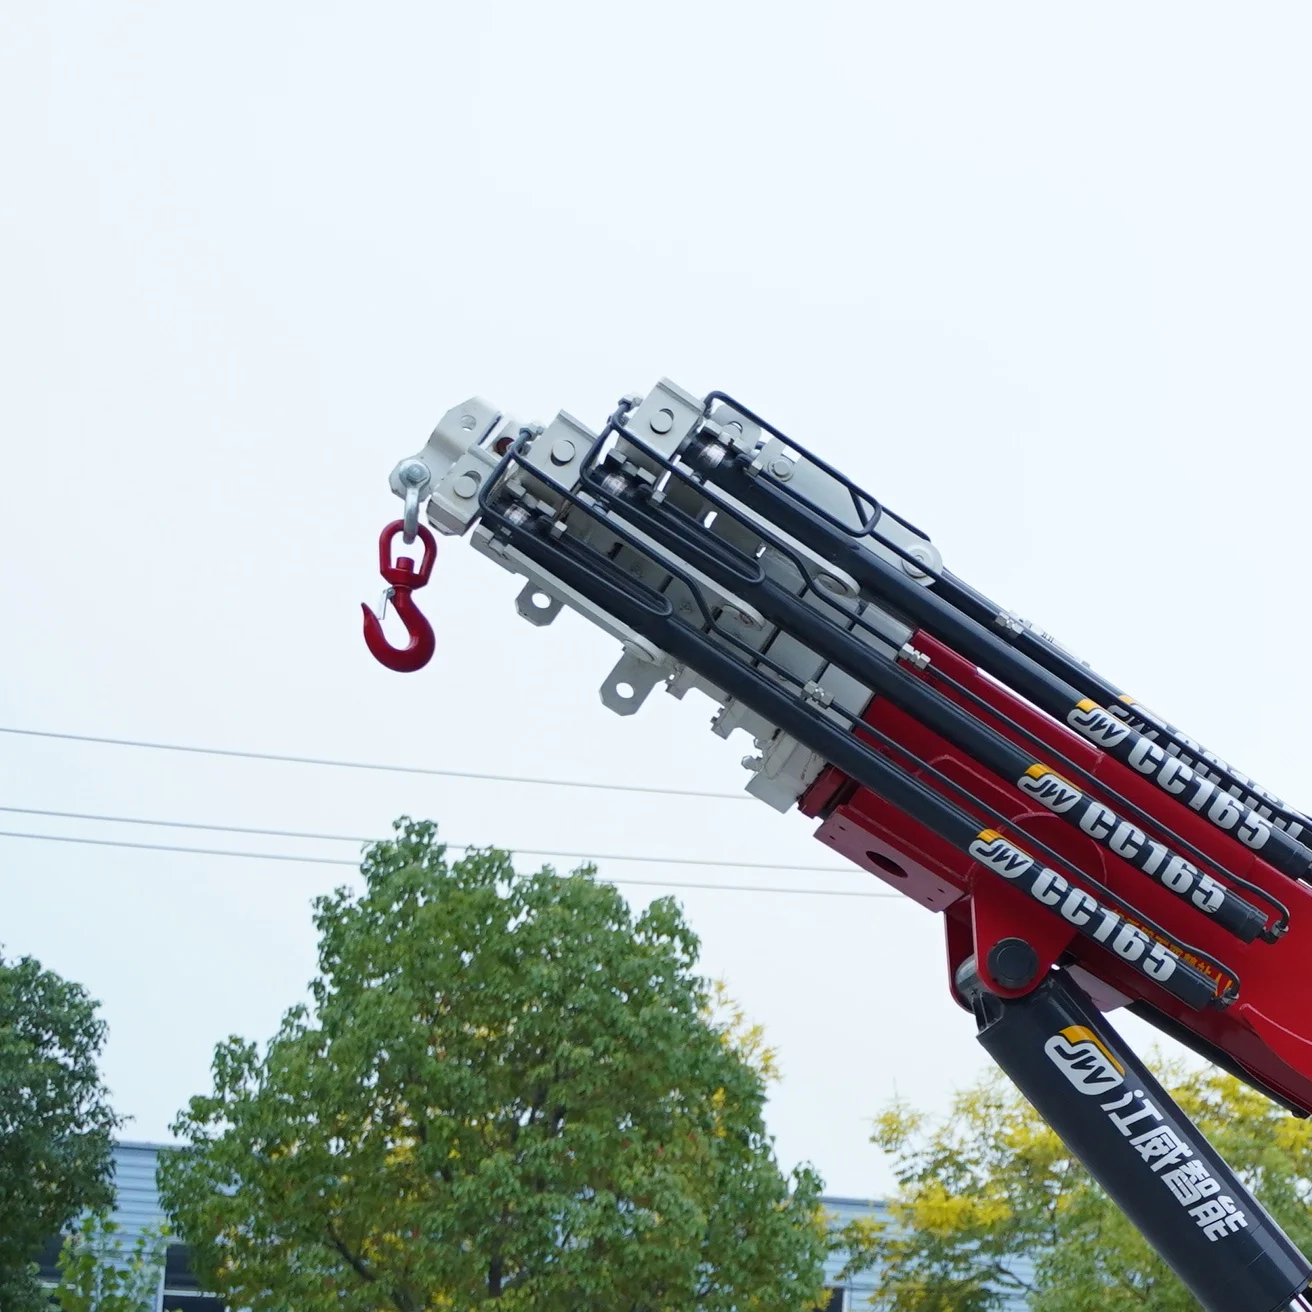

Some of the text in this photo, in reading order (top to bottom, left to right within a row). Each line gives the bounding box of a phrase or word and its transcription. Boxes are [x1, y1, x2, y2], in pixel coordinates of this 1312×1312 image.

[1127, 737, 1274, 850] CC165
[1079, 801, 1227, 913] CC165
[1030, 867, 1179, 981] CC165
[1100, 1089, 1249, 1242] 江威智能
